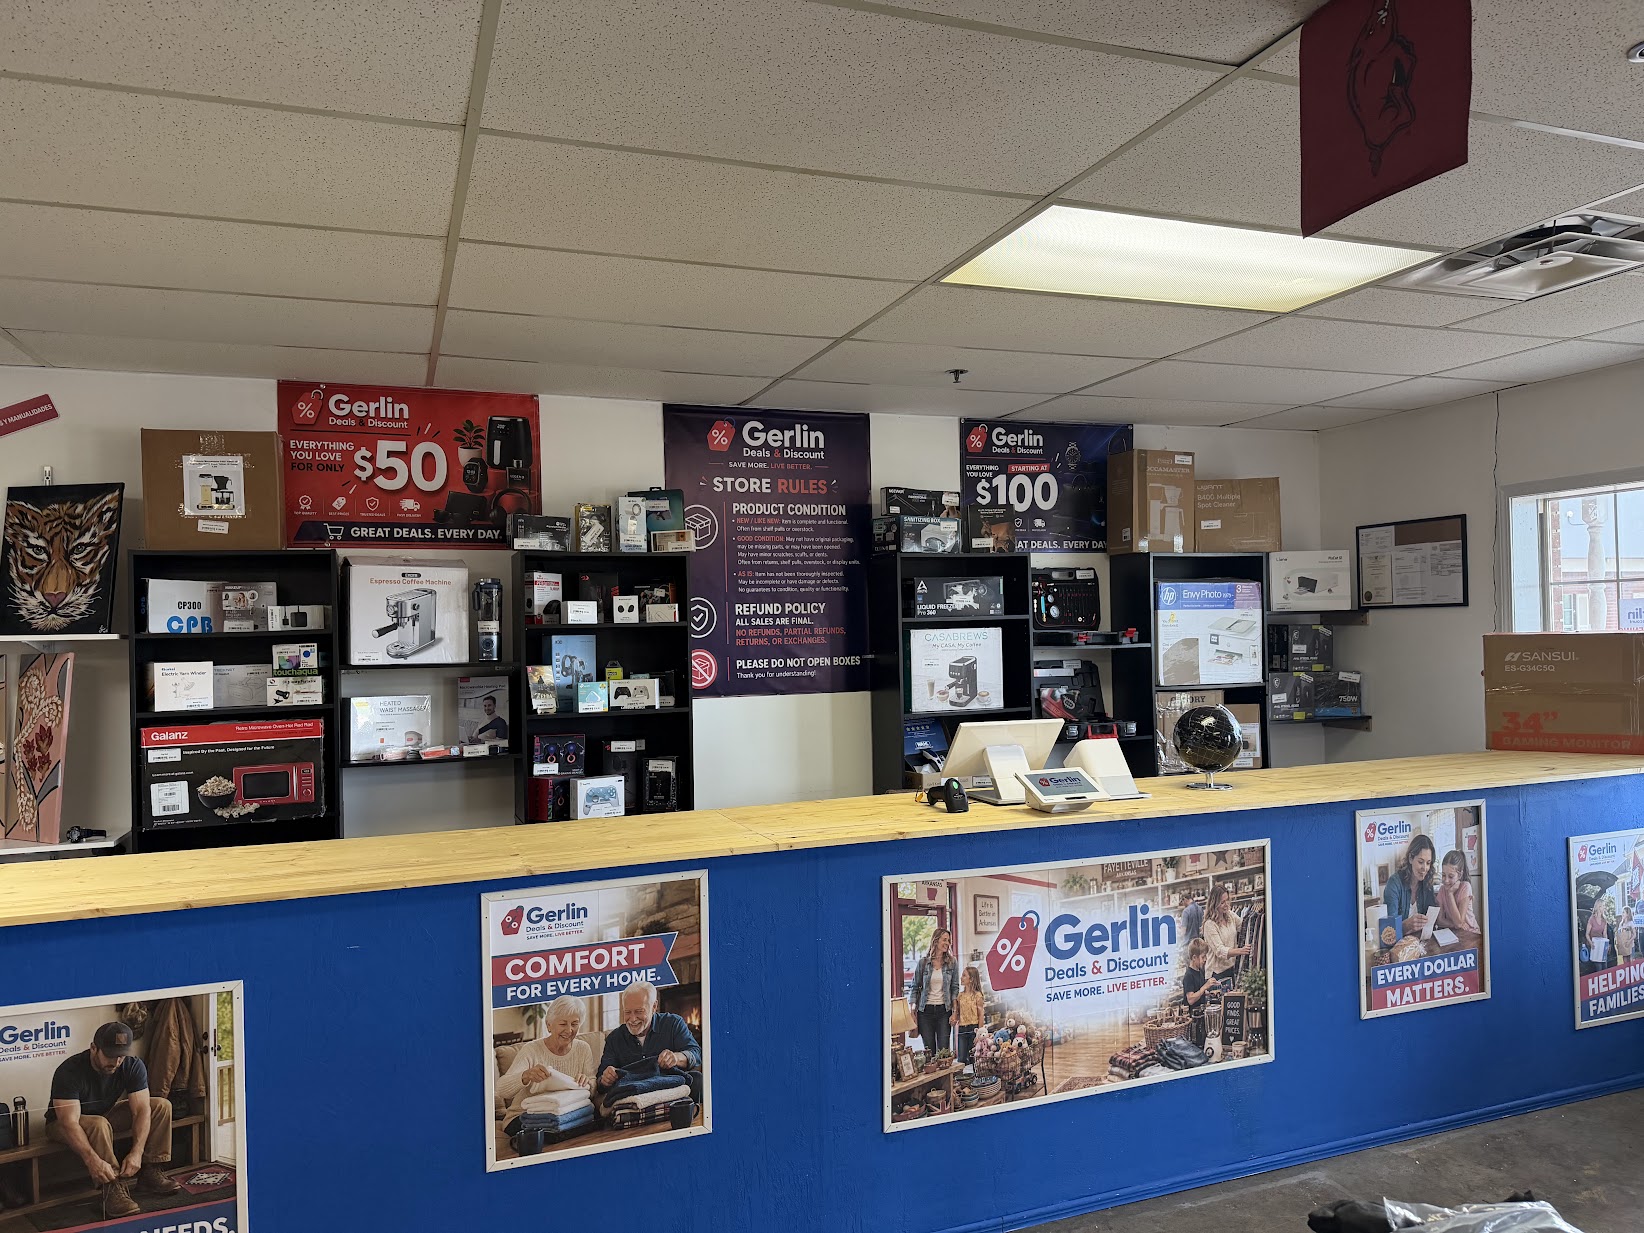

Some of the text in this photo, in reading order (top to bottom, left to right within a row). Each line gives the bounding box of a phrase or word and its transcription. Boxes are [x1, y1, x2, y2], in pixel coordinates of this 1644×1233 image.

[328, 393, 409, 419] Gerlin
[8, 403, 53, 424] MANUALIDADES
[328, 417, 356, 426] Deals
[368, 419, 408, 429] Discount
[742, 420, 825, 448] Gerlin
[991, 427, 1043, 447] Gerlin
[290, 440, 355, 451] EVERYTHING
[992, 446, 1010, 454] Deals
[1016, 447, 1043, 455] Discount
[290, 451, 342, 461] YOU LOVE
[743, 448, 825, 459] Deals & Discount
[291, 462, 345, 472] FOR ONLY
[353, 440, 448, 492] $50
[713, 476, 828, 495] STORE RULES
[976, 472, 1059, 513] $100
[732, 503, 846, 515] PRODUCT CONDITION
[351, 526, 503, 540] GREAT DEALS. EVERY DAY.
[1030, 540, 1061, 549] DEALS.
[1063, 540, 1090, 549] EVERY
[369, 578, 400, 586] Espresso
[1161, 587, 1176, 605] hp
[1183, 589, 1222, 600] Envy Photo
[178, 601, 202, 610] CP300
[735, 602, 826, 616] REFUND POLICY
[166, 616, 213, 634] CPB
[735, 617, 814, 626] ALL SALES ARE FINAL.
[735, 627, 847, 637] NO REFUNDS, PARTIAL REFUNDS,
[924, 631, 988, 642] CASABREWS
[736, 636, 827, 646] RETURNS, OR EXCHANGES.
[1522, 651, 1575, 661] SANSUI
[736, 656, 861, 669] PLEASE DO NOT OPEN BOXES
[1505, 664, 1555, 672] ES-G34C5Q
[755, 672, 766, 680] you
[775, 670, 817, 678] understanding!
[151, 731, 188, 741] Galanz
[1502, 737, 1631, 749] GAMING MONITOR
[1049, 776, 1082, 784] Gerlin
[1378, 821, 1411, 835] Gerlin
[1589, 842, 1617, 856] Gerlin
[1103, 859, 1149, 873] FAYETTEVILLE
[981, 901, 994, 909] Life is
[526, 902, 588, 924] Gerlin
[554, 921, 584, 930] Discount
[1044, 903, 1177, 960] Gerlin
[505, 943, 645, 981] COMFORT
[1045, 952, 1169, 982] Deals & Discount
[1377, 953, 1475, 985] EVERY DOLLAR
[506, 968, 661, 1001] FOR EVERY HOME.
[1046, 976, 1167, 1003] SAVE MORE. LIVE BETTER.
[1386, 976, 1470, 1008] MATTERS.
[1226, 1001, 1240, 1009] GOOD
[0, 1021, 70, 1045] Gerlin
[1225, 1026, 1240, 1034] PRICES.
[32, 1040, 67, 1050] Discount
